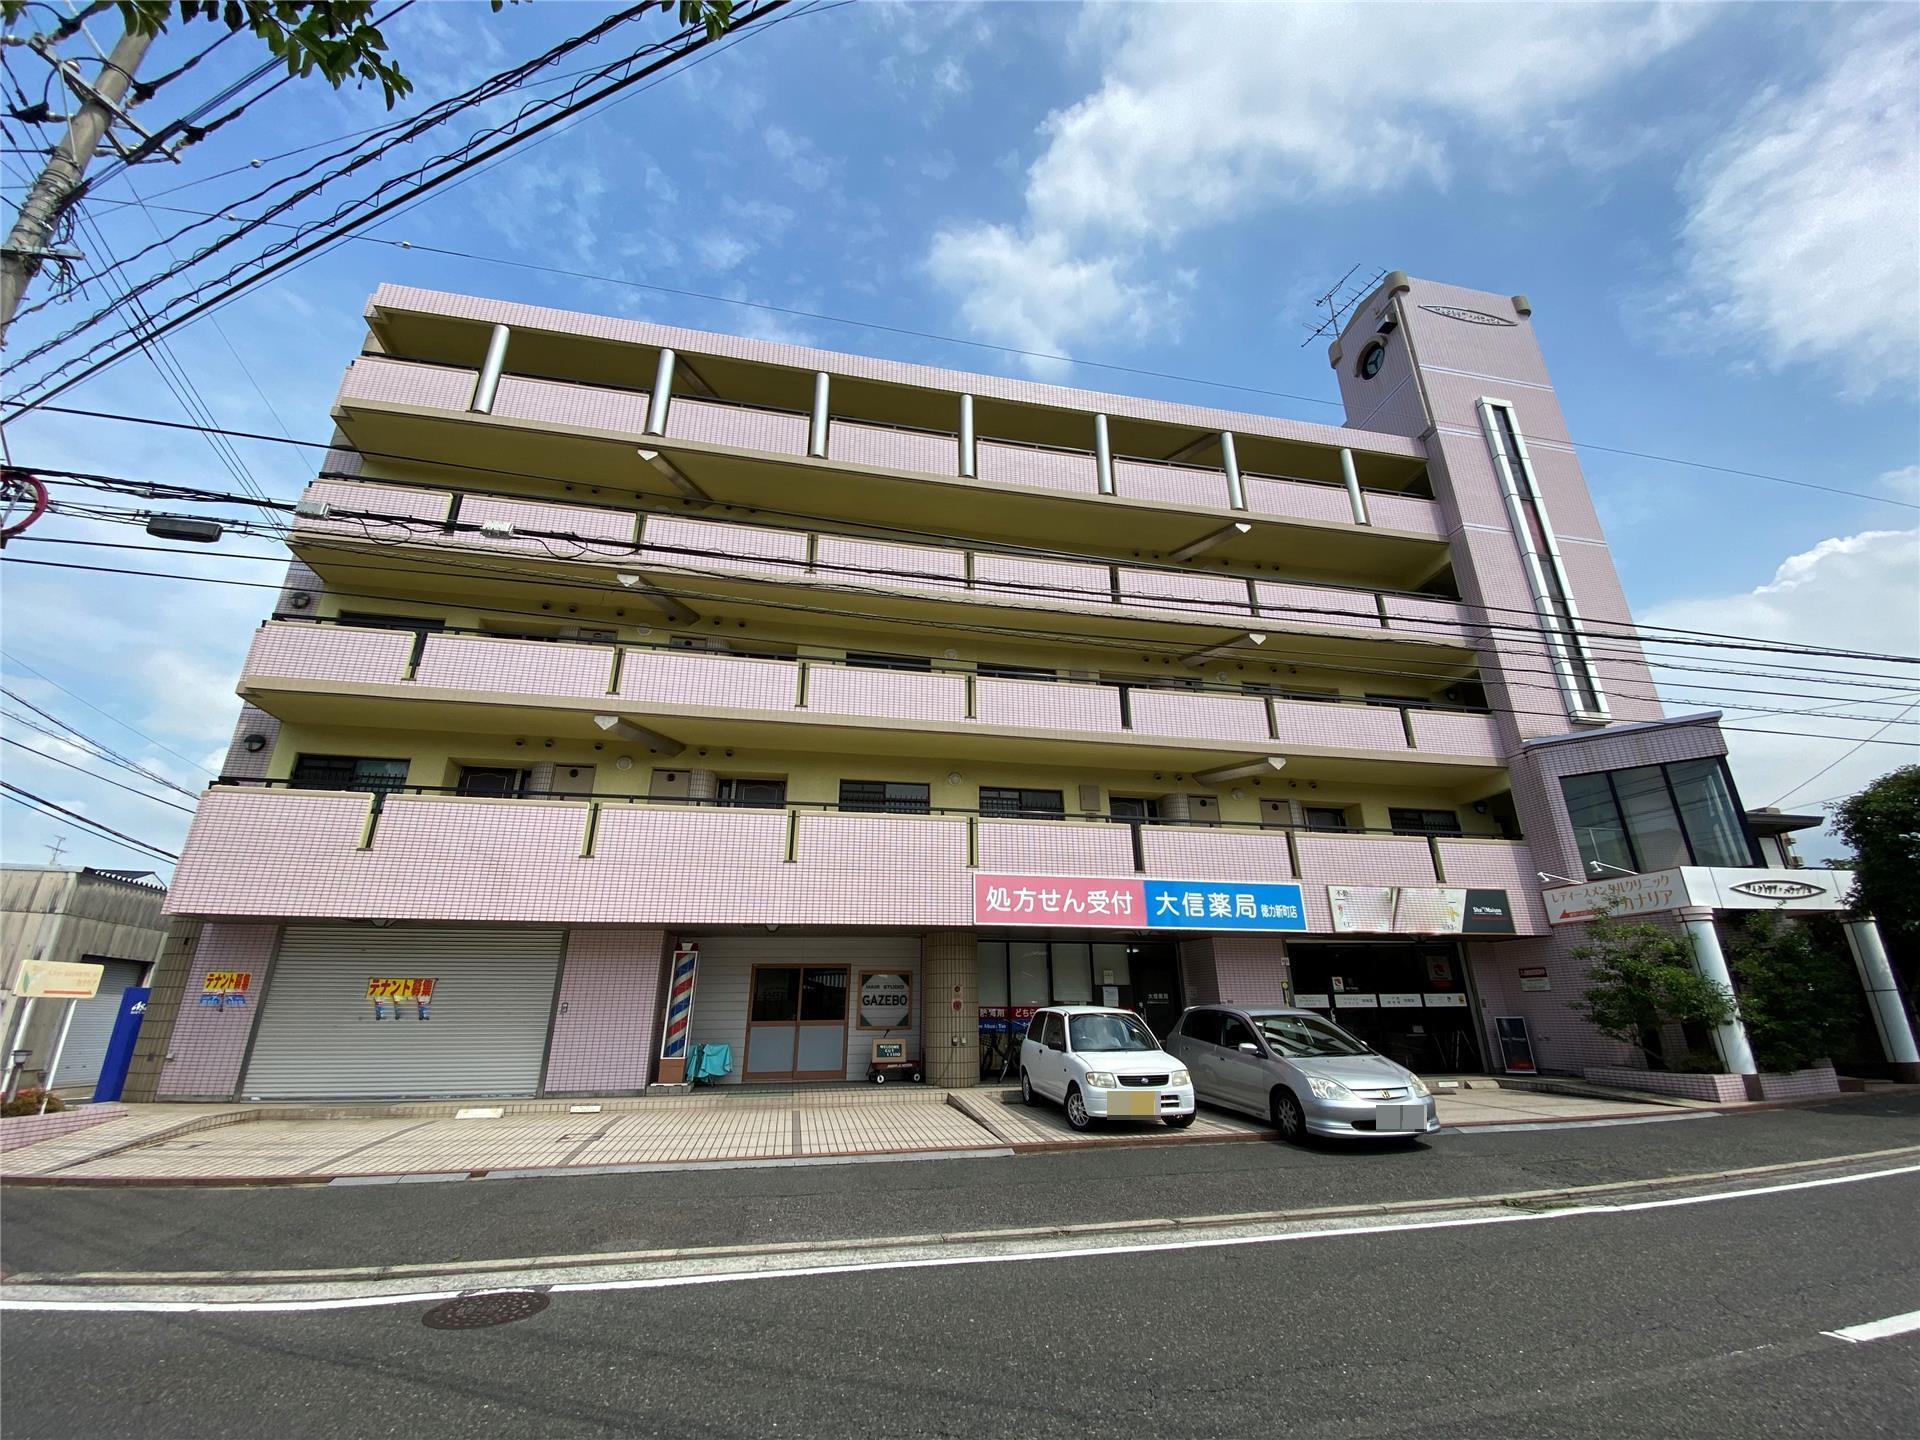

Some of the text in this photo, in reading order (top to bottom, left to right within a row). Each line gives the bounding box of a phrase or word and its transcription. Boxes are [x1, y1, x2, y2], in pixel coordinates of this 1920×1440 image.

[985, 886, 1133, 915] 処方せん受付
[1155, 891, 1297, 919] 大信薬局 徳力新町店
[1623, 889, 1673, 910] カナリア
[369, 977, 433, 996] テナント募集
[862, 994, 908, 1006] GAZEBO
